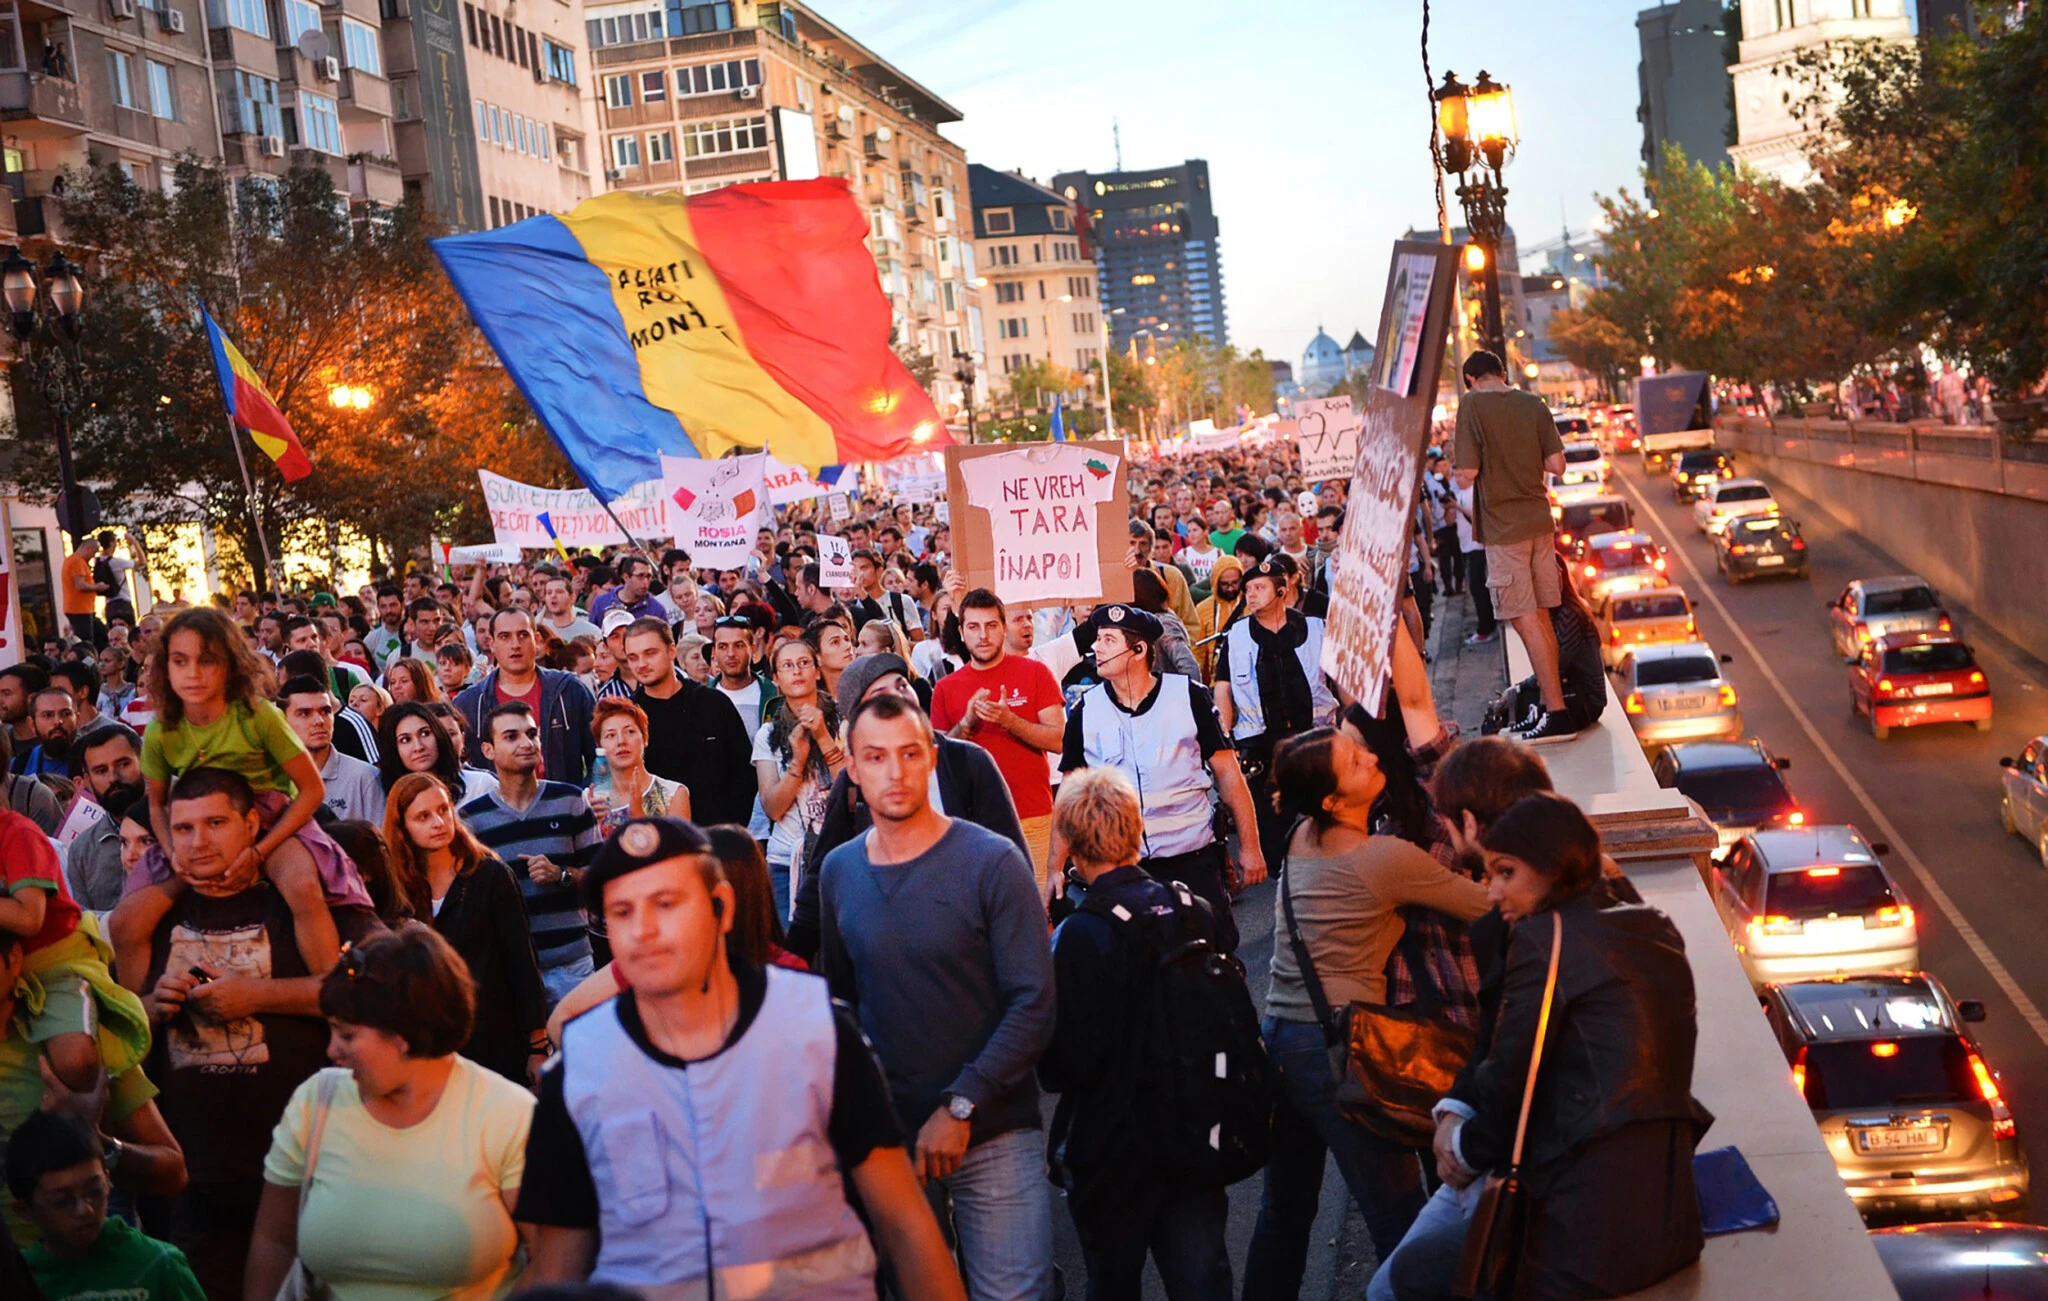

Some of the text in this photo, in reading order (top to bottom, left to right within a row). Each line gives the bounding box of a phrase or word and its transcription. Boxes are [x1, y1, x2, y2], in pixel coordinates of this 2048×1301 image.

[1003, 478, 1029, 502] NE
[694, 538, 747, 548] MONTANA
[1000, 548, 1081, 581] ÎNAPOI
